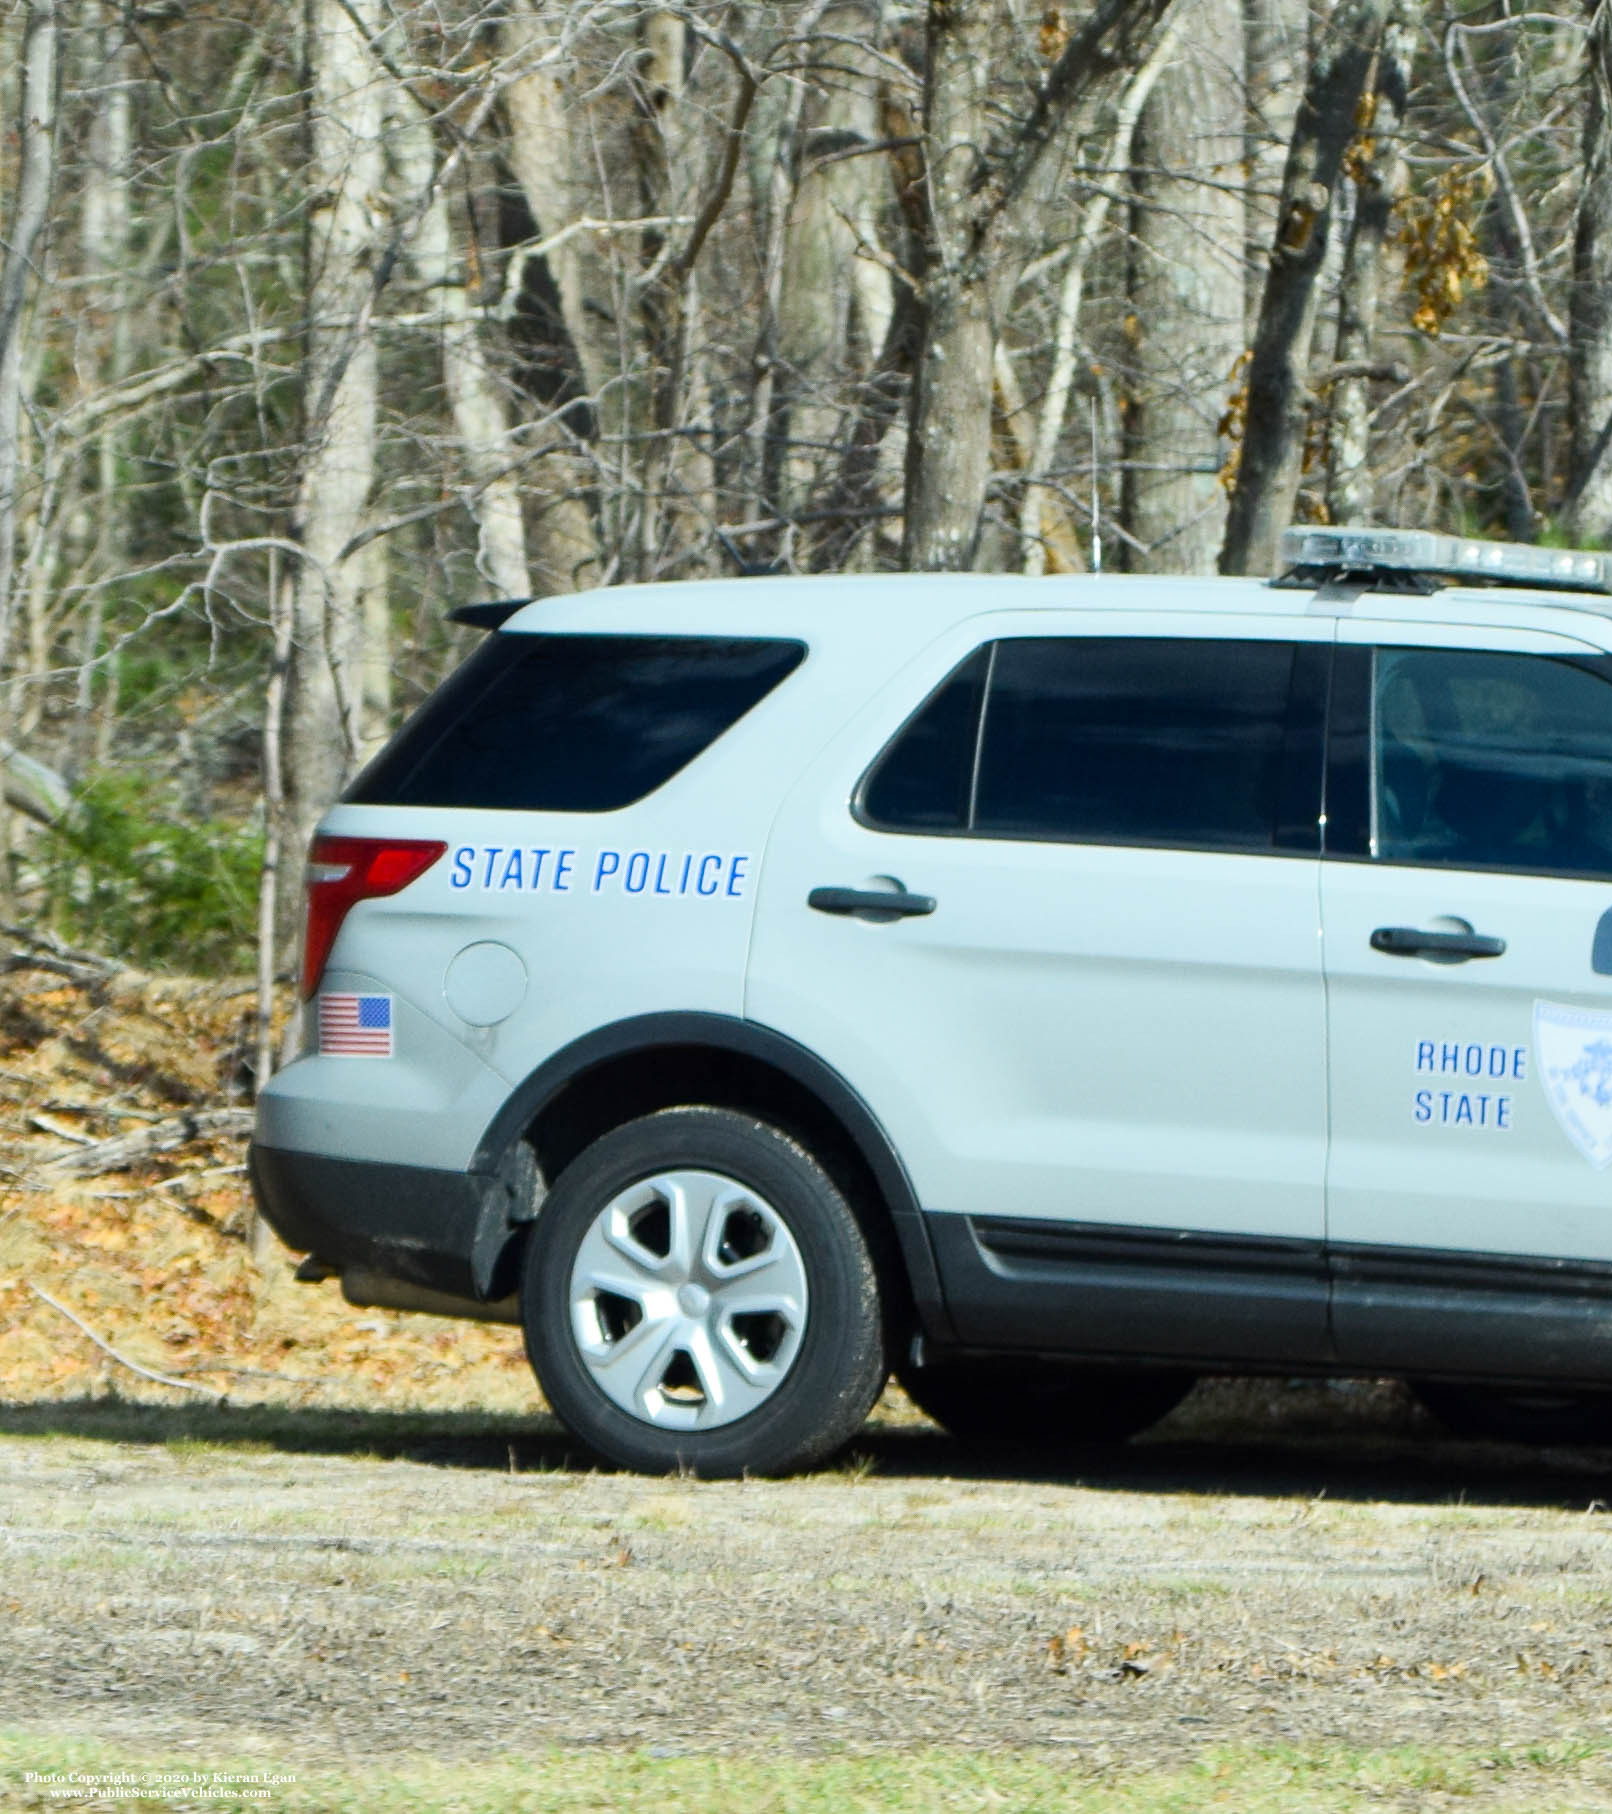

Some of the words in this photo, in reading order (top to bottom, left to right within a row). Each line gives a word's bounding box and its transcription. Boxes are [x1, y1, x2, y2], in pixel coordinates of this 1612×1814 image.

[450, 847, 576, 891] STATE
[593, 850, 749, 897] POLICE
[1416, 1040, 1527, 1080] RHODE
[1415, 1089, 1510, 1129] STATE
